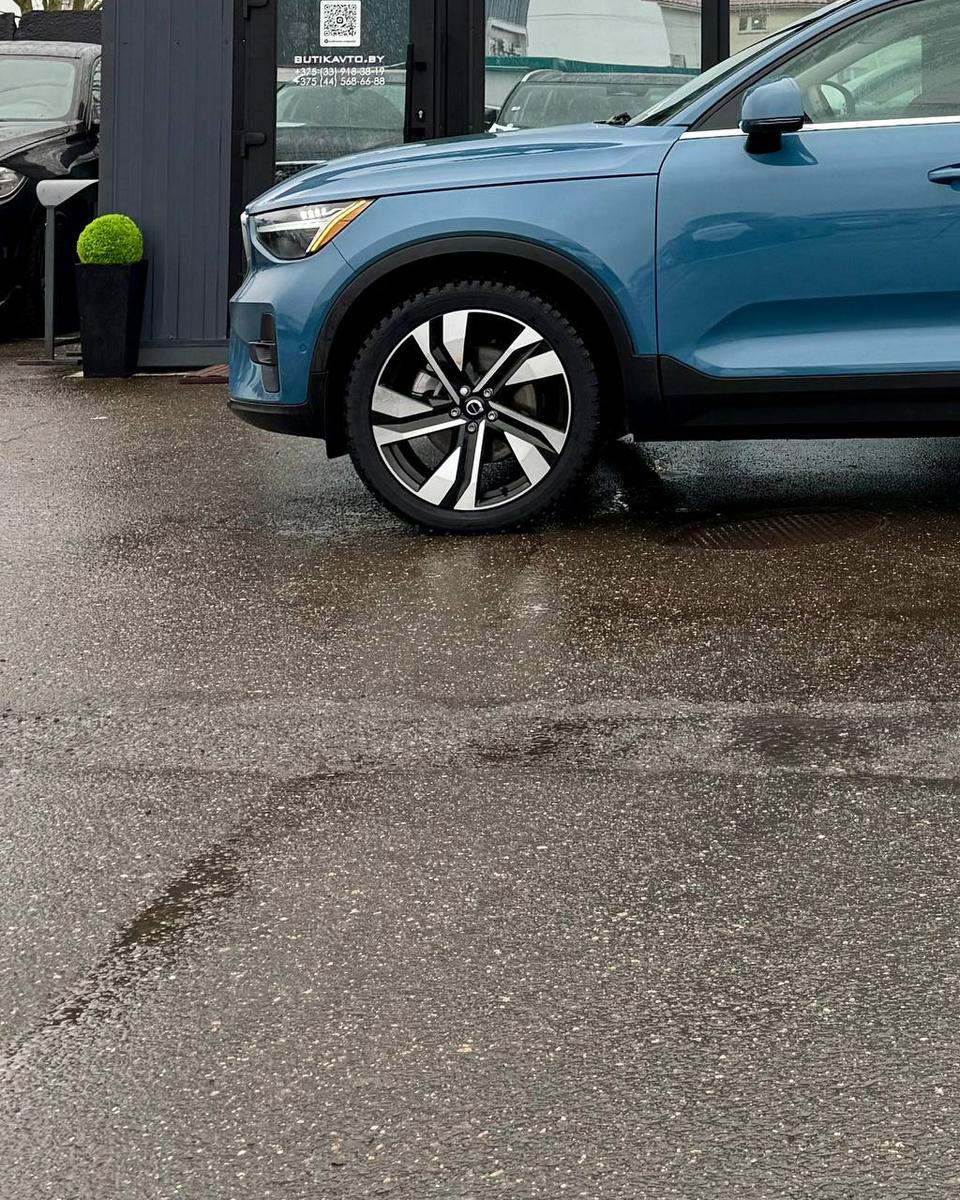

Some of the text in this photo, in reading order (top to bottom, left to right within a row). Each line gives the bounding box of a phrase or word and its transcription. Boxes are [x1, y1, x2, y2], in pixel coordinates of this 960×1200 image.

[294, 55, 386, 64] BUTIKAVTO.BY
[296, 77, 318, 87] +375
[319, 76, 338, 88] (44)
